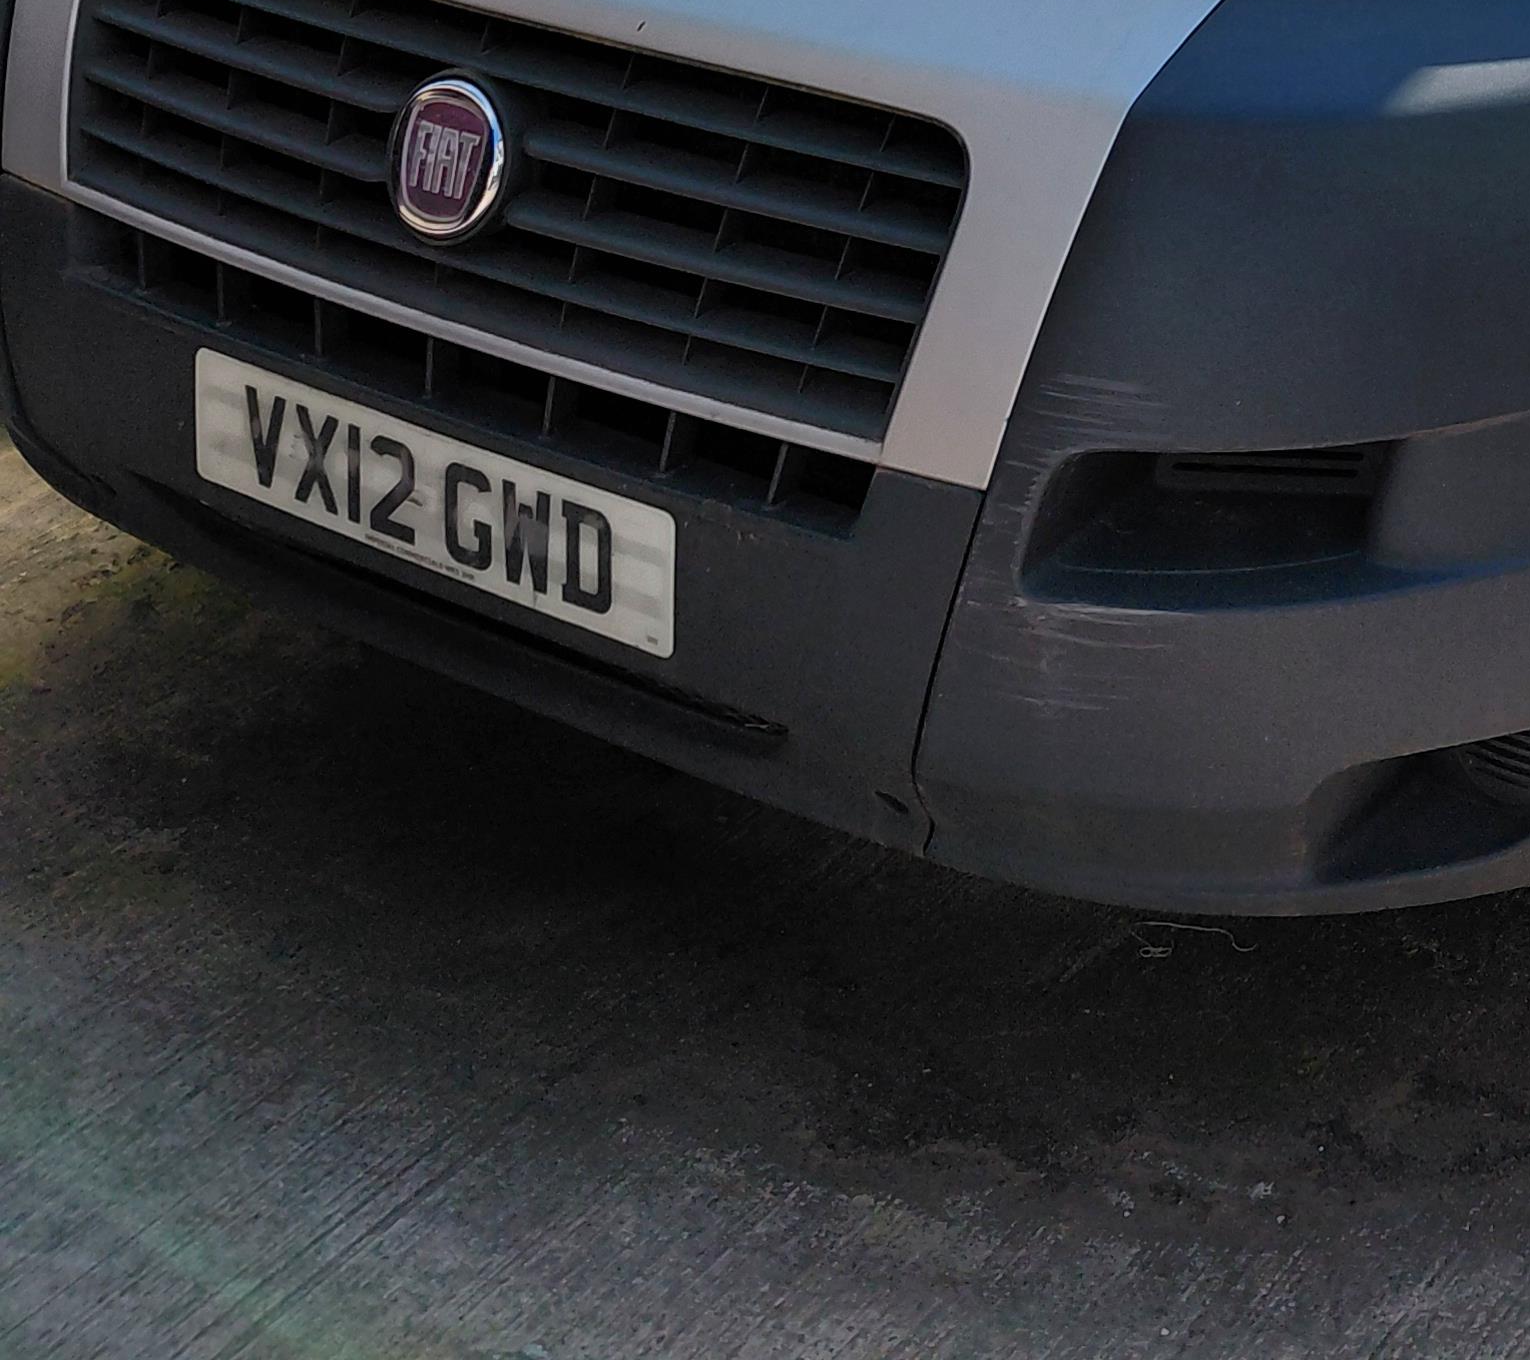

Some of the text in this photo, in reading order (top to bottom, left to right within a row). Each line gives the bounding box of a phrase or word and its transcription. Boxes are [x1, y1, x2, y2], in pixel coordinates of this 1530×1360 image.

[410, 118, 482, 200] FIAT
[244, 384, 613, 615] VX12 GWD
